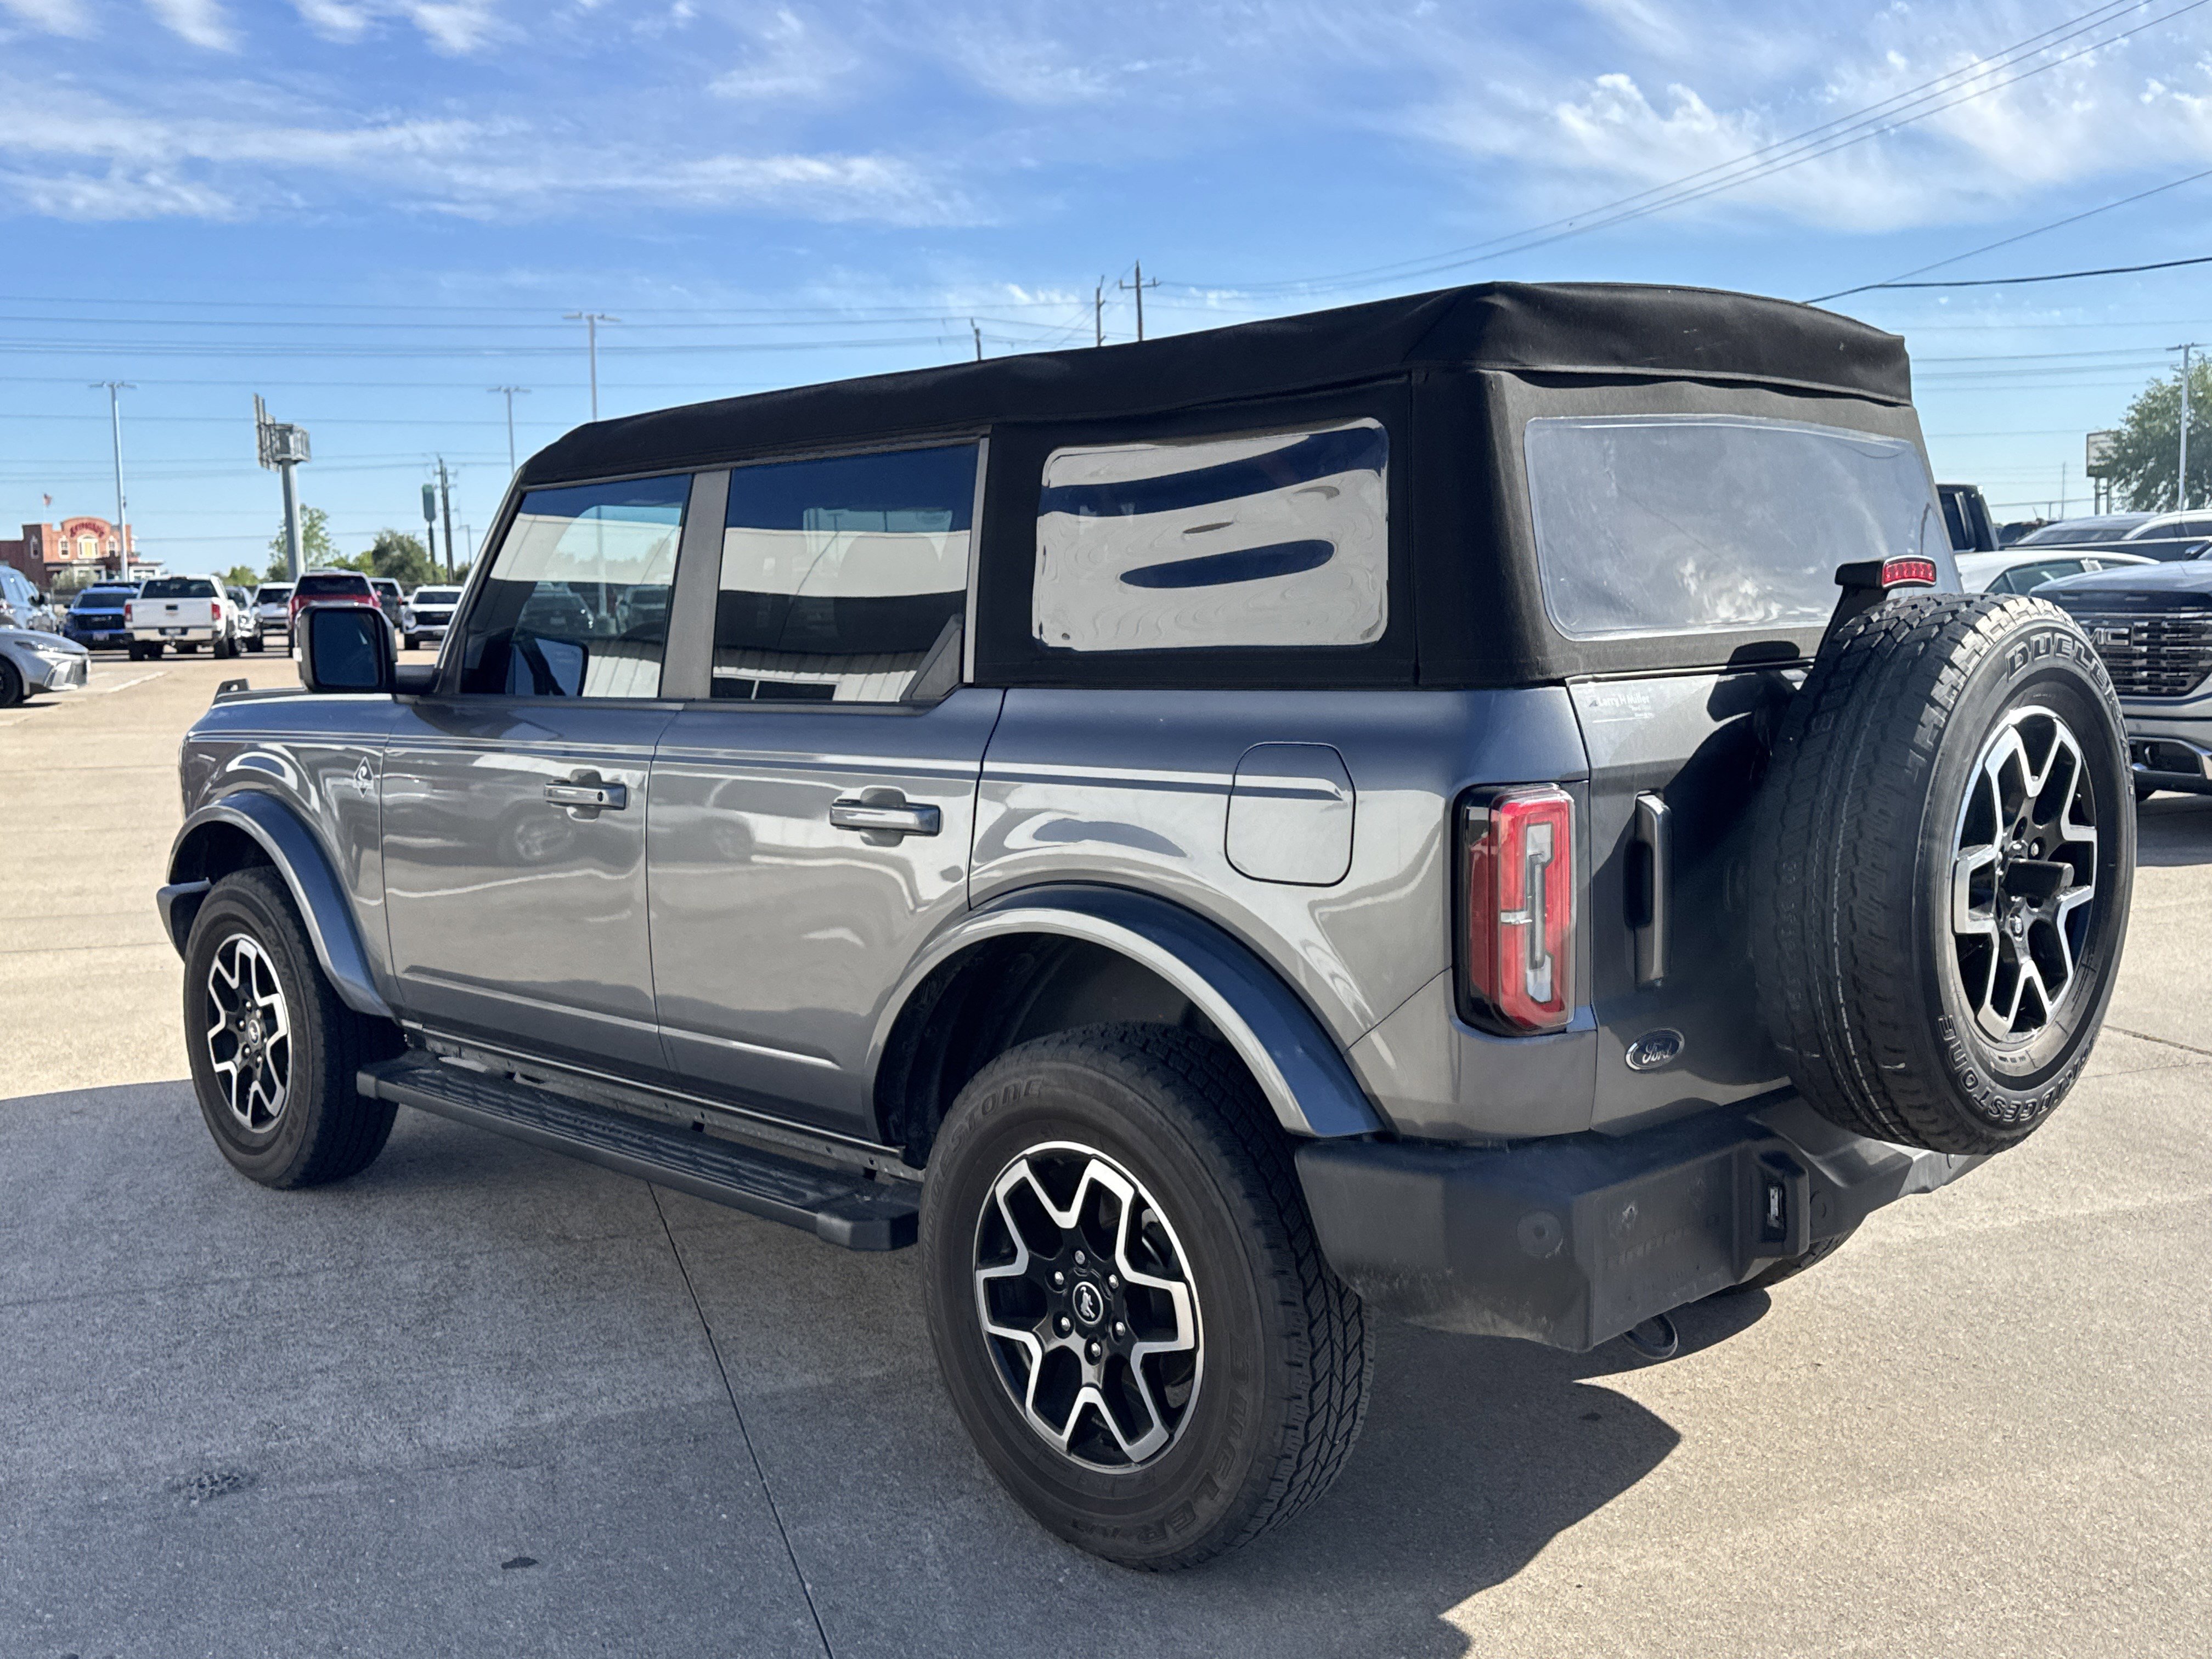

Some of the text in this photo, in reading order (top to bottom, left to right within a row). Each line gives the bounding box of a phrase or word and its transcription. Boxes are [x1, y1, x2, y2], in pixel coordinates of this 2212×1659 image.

[2084, 627, 2130, 646] MC
[1596, 697, 1619, 708] Larry
[1627, 692, 1650, 704] Miller
[1137, 1331, 1251, 1545] DUELER
